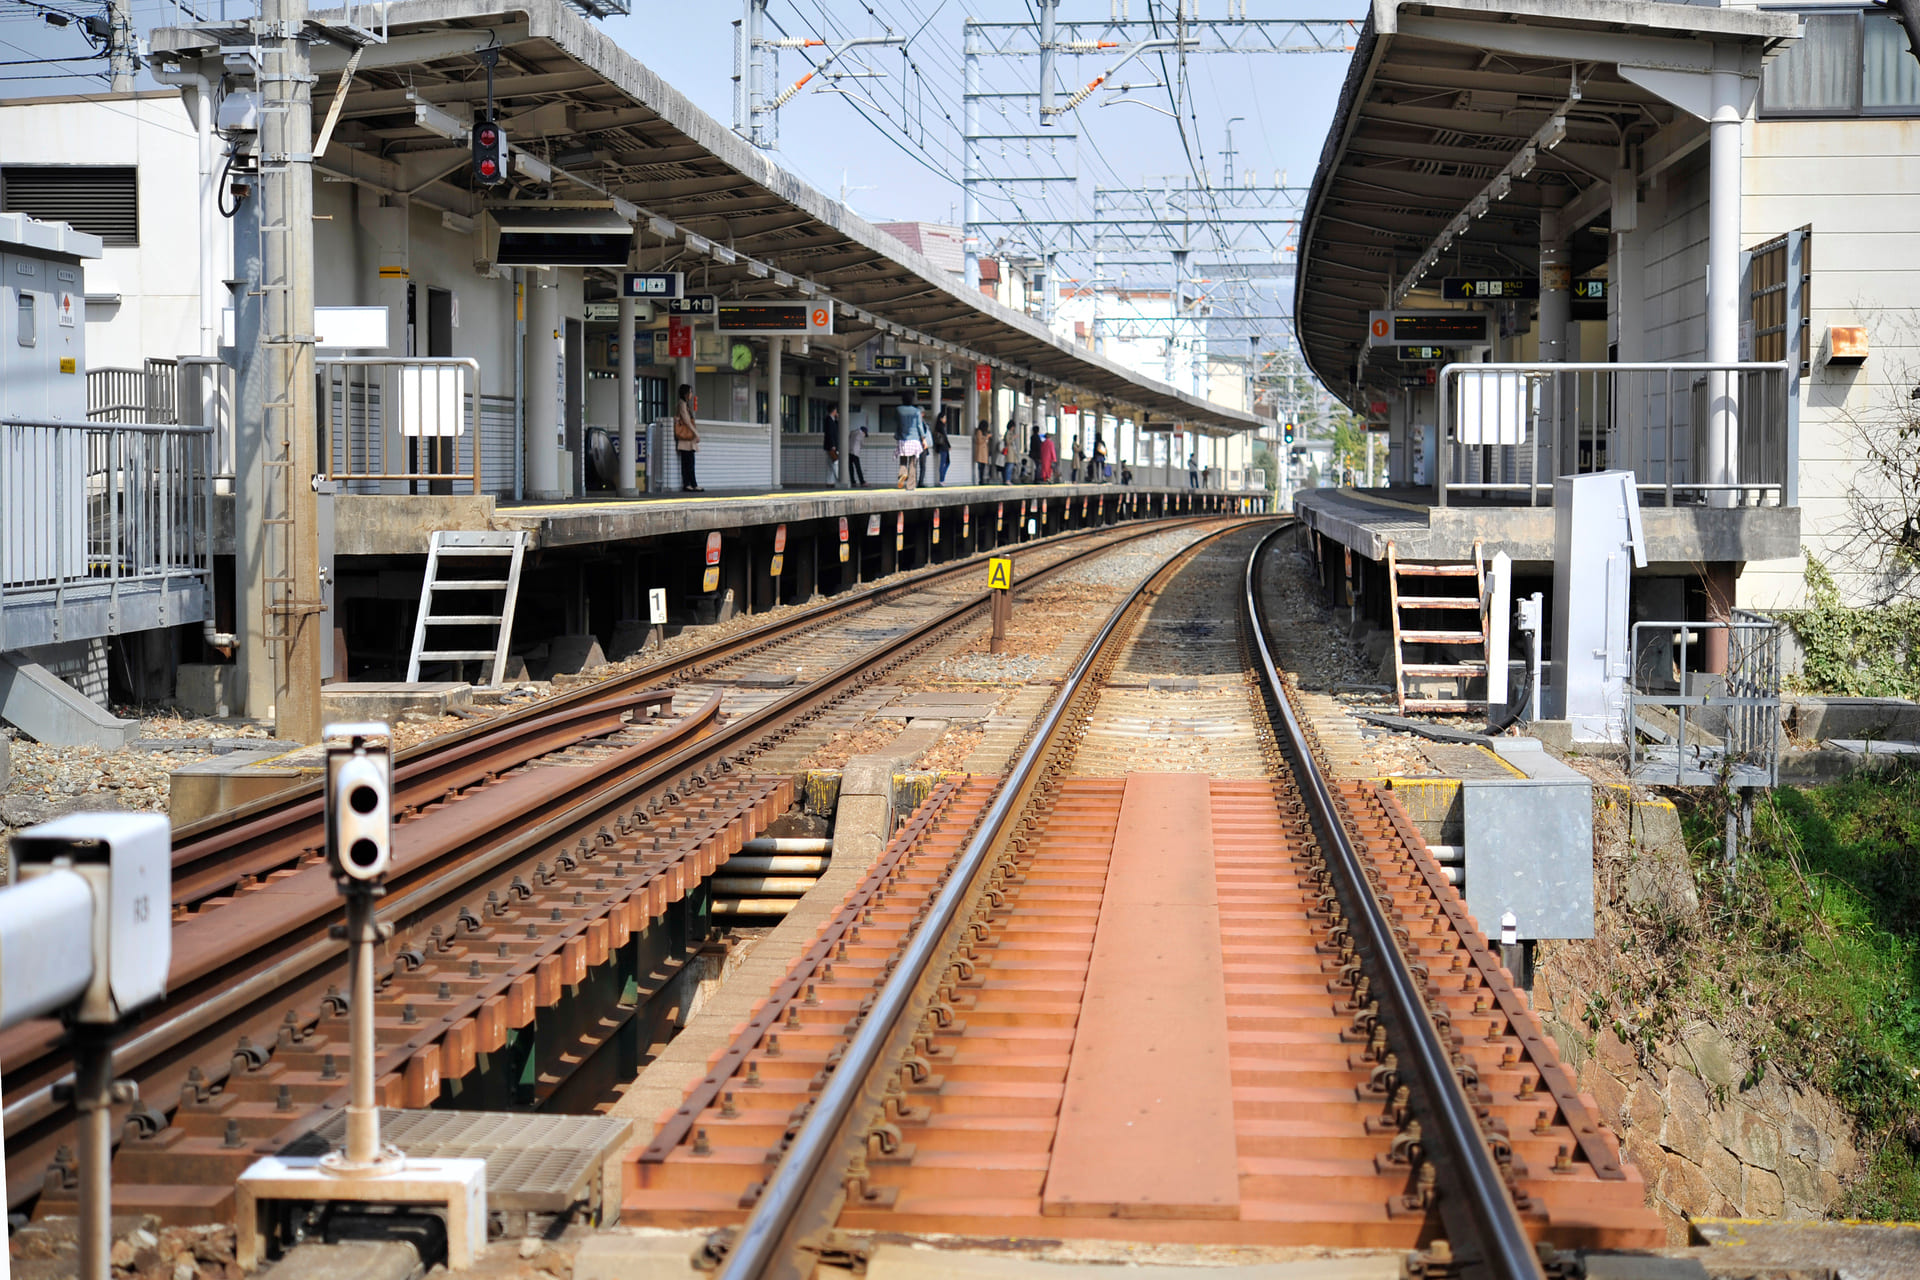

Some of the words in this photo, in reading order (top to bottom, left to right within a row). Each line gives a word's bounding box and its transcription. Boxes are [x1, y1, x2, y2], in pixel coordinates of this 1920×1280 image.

[815, 311, 825, 324] 2
[1376, 321, 1383, 335] 1
[991, 562, 1007, 586] A
[651, 592, 660, 611] 1
